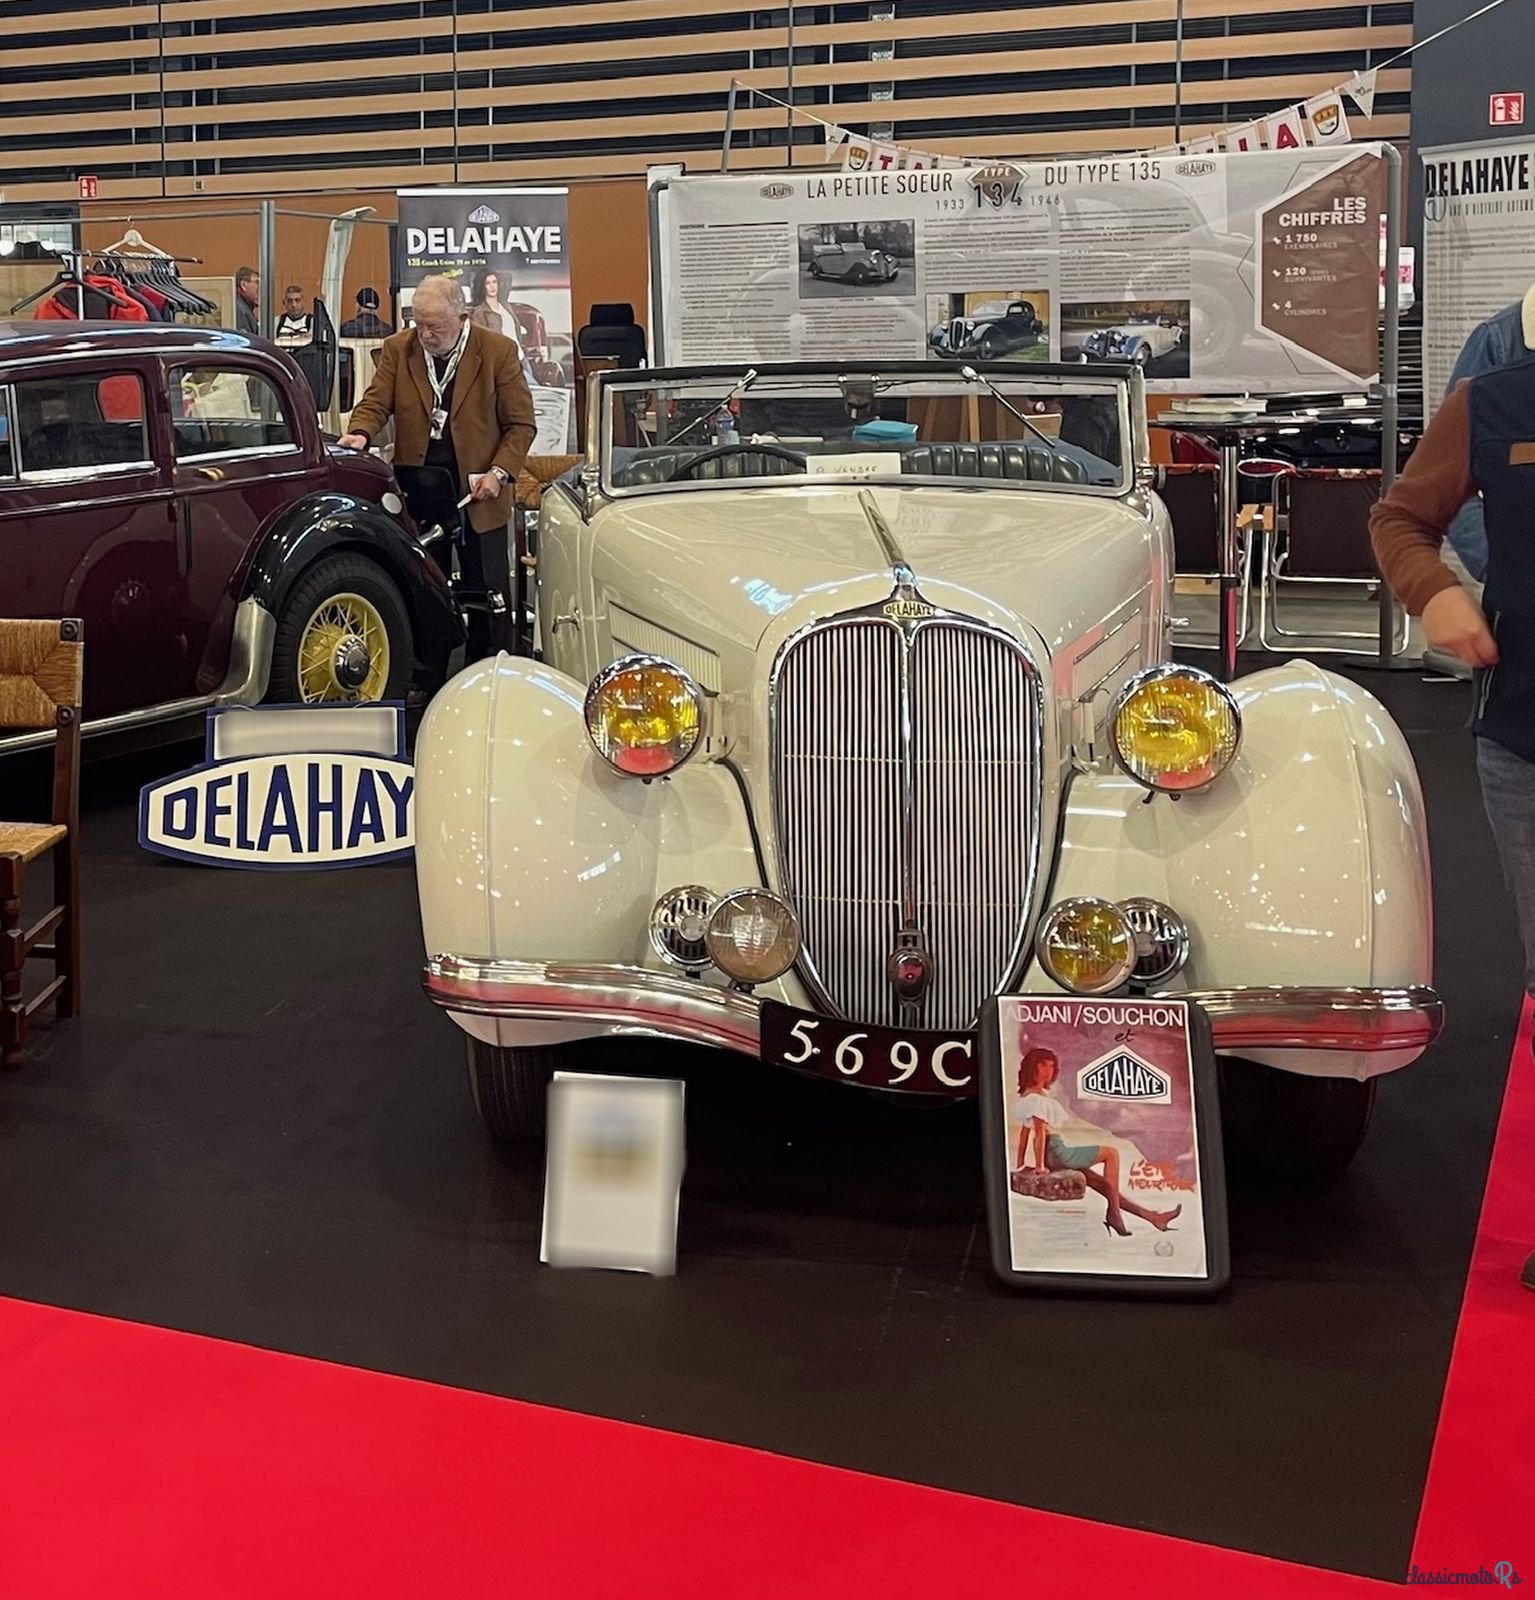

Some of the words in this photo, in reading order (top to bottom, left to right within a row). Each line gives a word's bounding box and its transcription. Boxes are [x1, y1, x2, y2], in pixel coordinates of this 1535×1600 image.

[983, 167, 1011, 177] TYPE
[1045, 165, 1068, 186] DU
[1077, 163, 1120, 184] TYPE
[1129, 161, 1161, 181] 135
[1425, 154, 1529, 197] DELAHAYE
[807, 179, 827, 199] LA
[833, 175, 889, 198] PETITE
[896, 172, 953, 194] SOEUR
[973, 181, 1023, 208] 134
[1031, 194, 1060, 206] 1946
[936, 198, 965, 210] 1933
[1333, 197, 1366, 211] LES
[1279, 211, 1366, 227] CHIFFRES
[406, 226, 562, 255] DELAHAYE
[1285, 267, 1307, 276] 120
[1284, 301, 1292, 309] 4
[163, 763, 414, 854] DELAHAY
[1114, 1029, 1135, 1042] et
[1088, 1058, 1161, 1096] DELAHAYE
